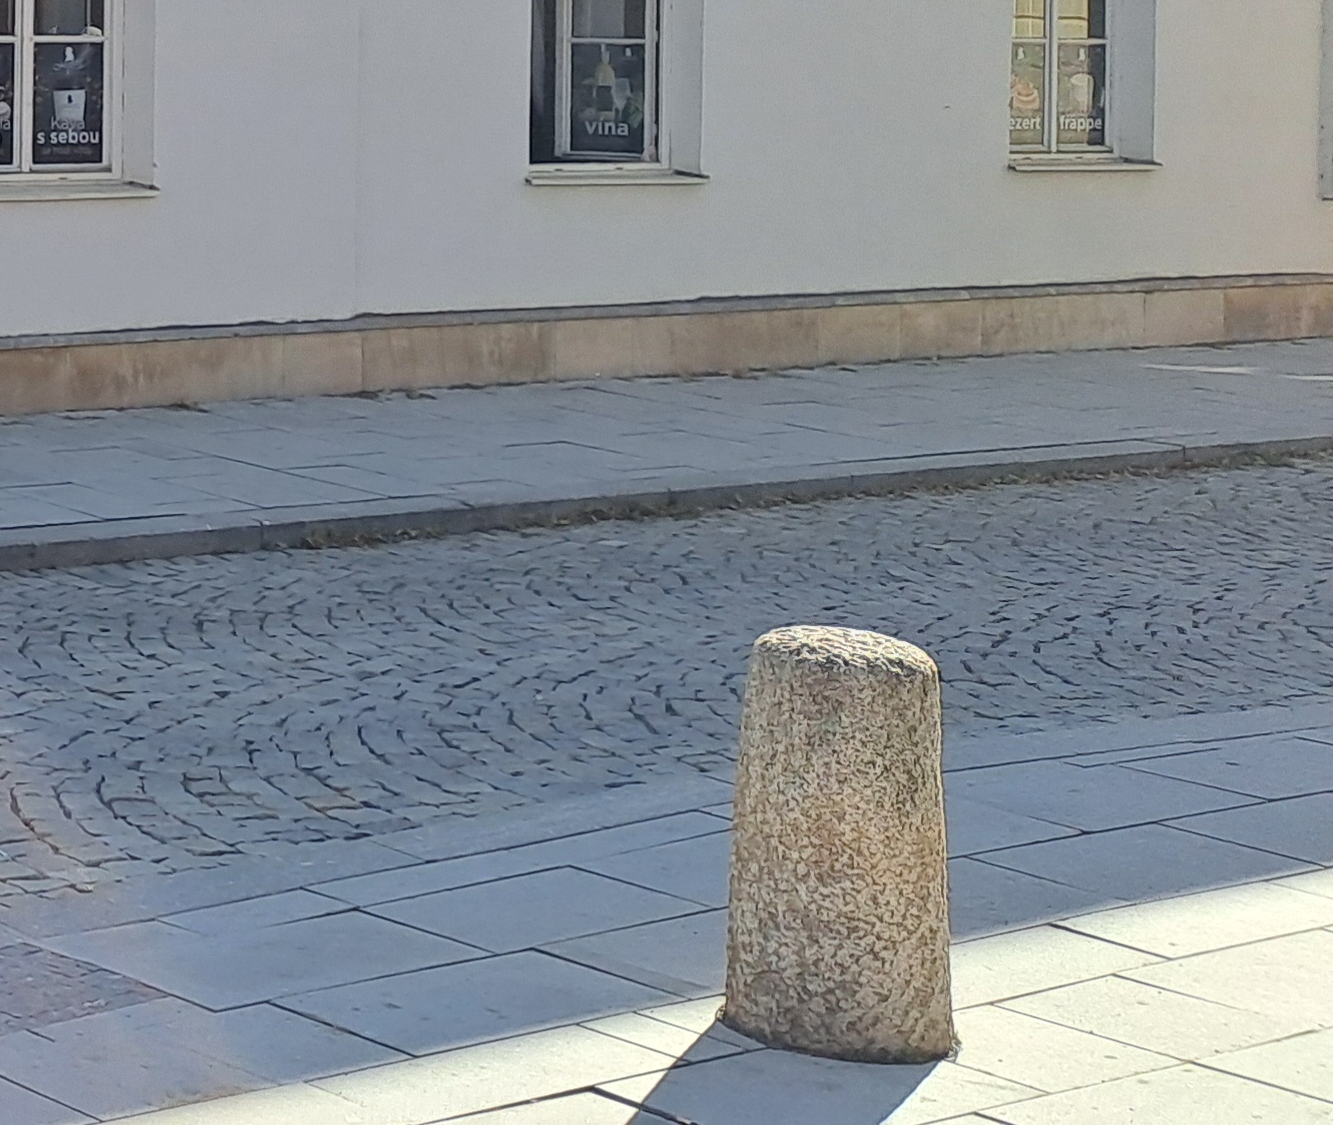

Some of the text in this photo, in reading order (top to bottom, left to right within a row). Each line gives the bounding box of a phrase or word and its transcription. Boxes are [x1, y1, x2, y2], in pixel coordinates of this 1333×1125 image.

[1009, 116, 1042, 130] ezert
[36, 128, 100, 145] s sebou
